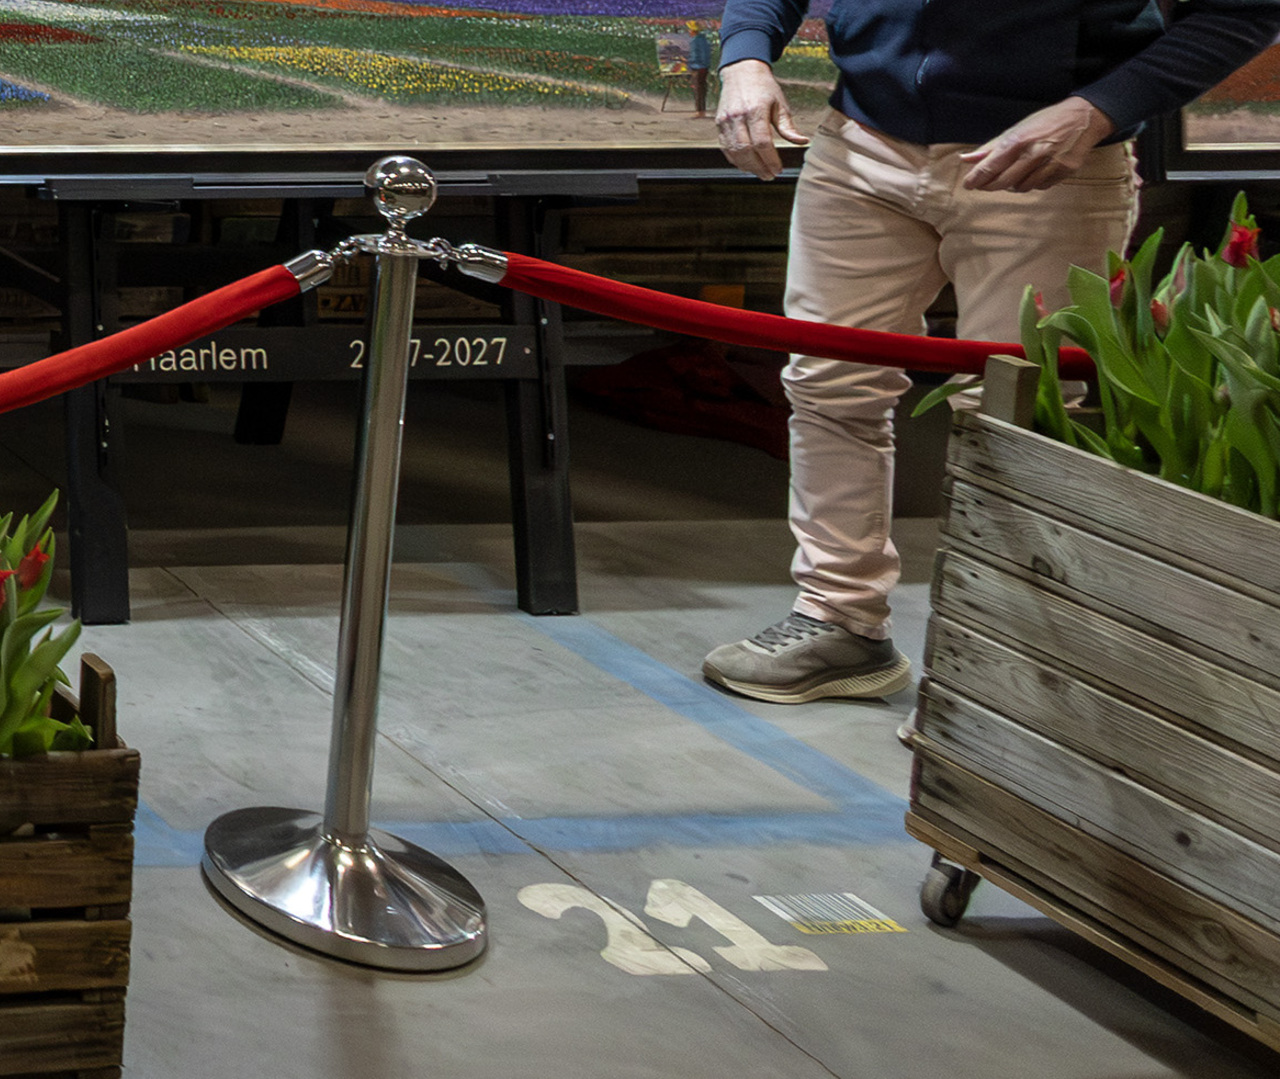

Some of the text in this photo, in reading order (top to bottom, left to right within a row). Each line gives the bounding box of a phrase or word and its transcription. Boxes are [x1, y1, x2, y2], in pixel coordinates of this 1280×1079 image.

[134, 336, 507, 372] aarlem 27-2027
[516, 877, 830, 977] 21
